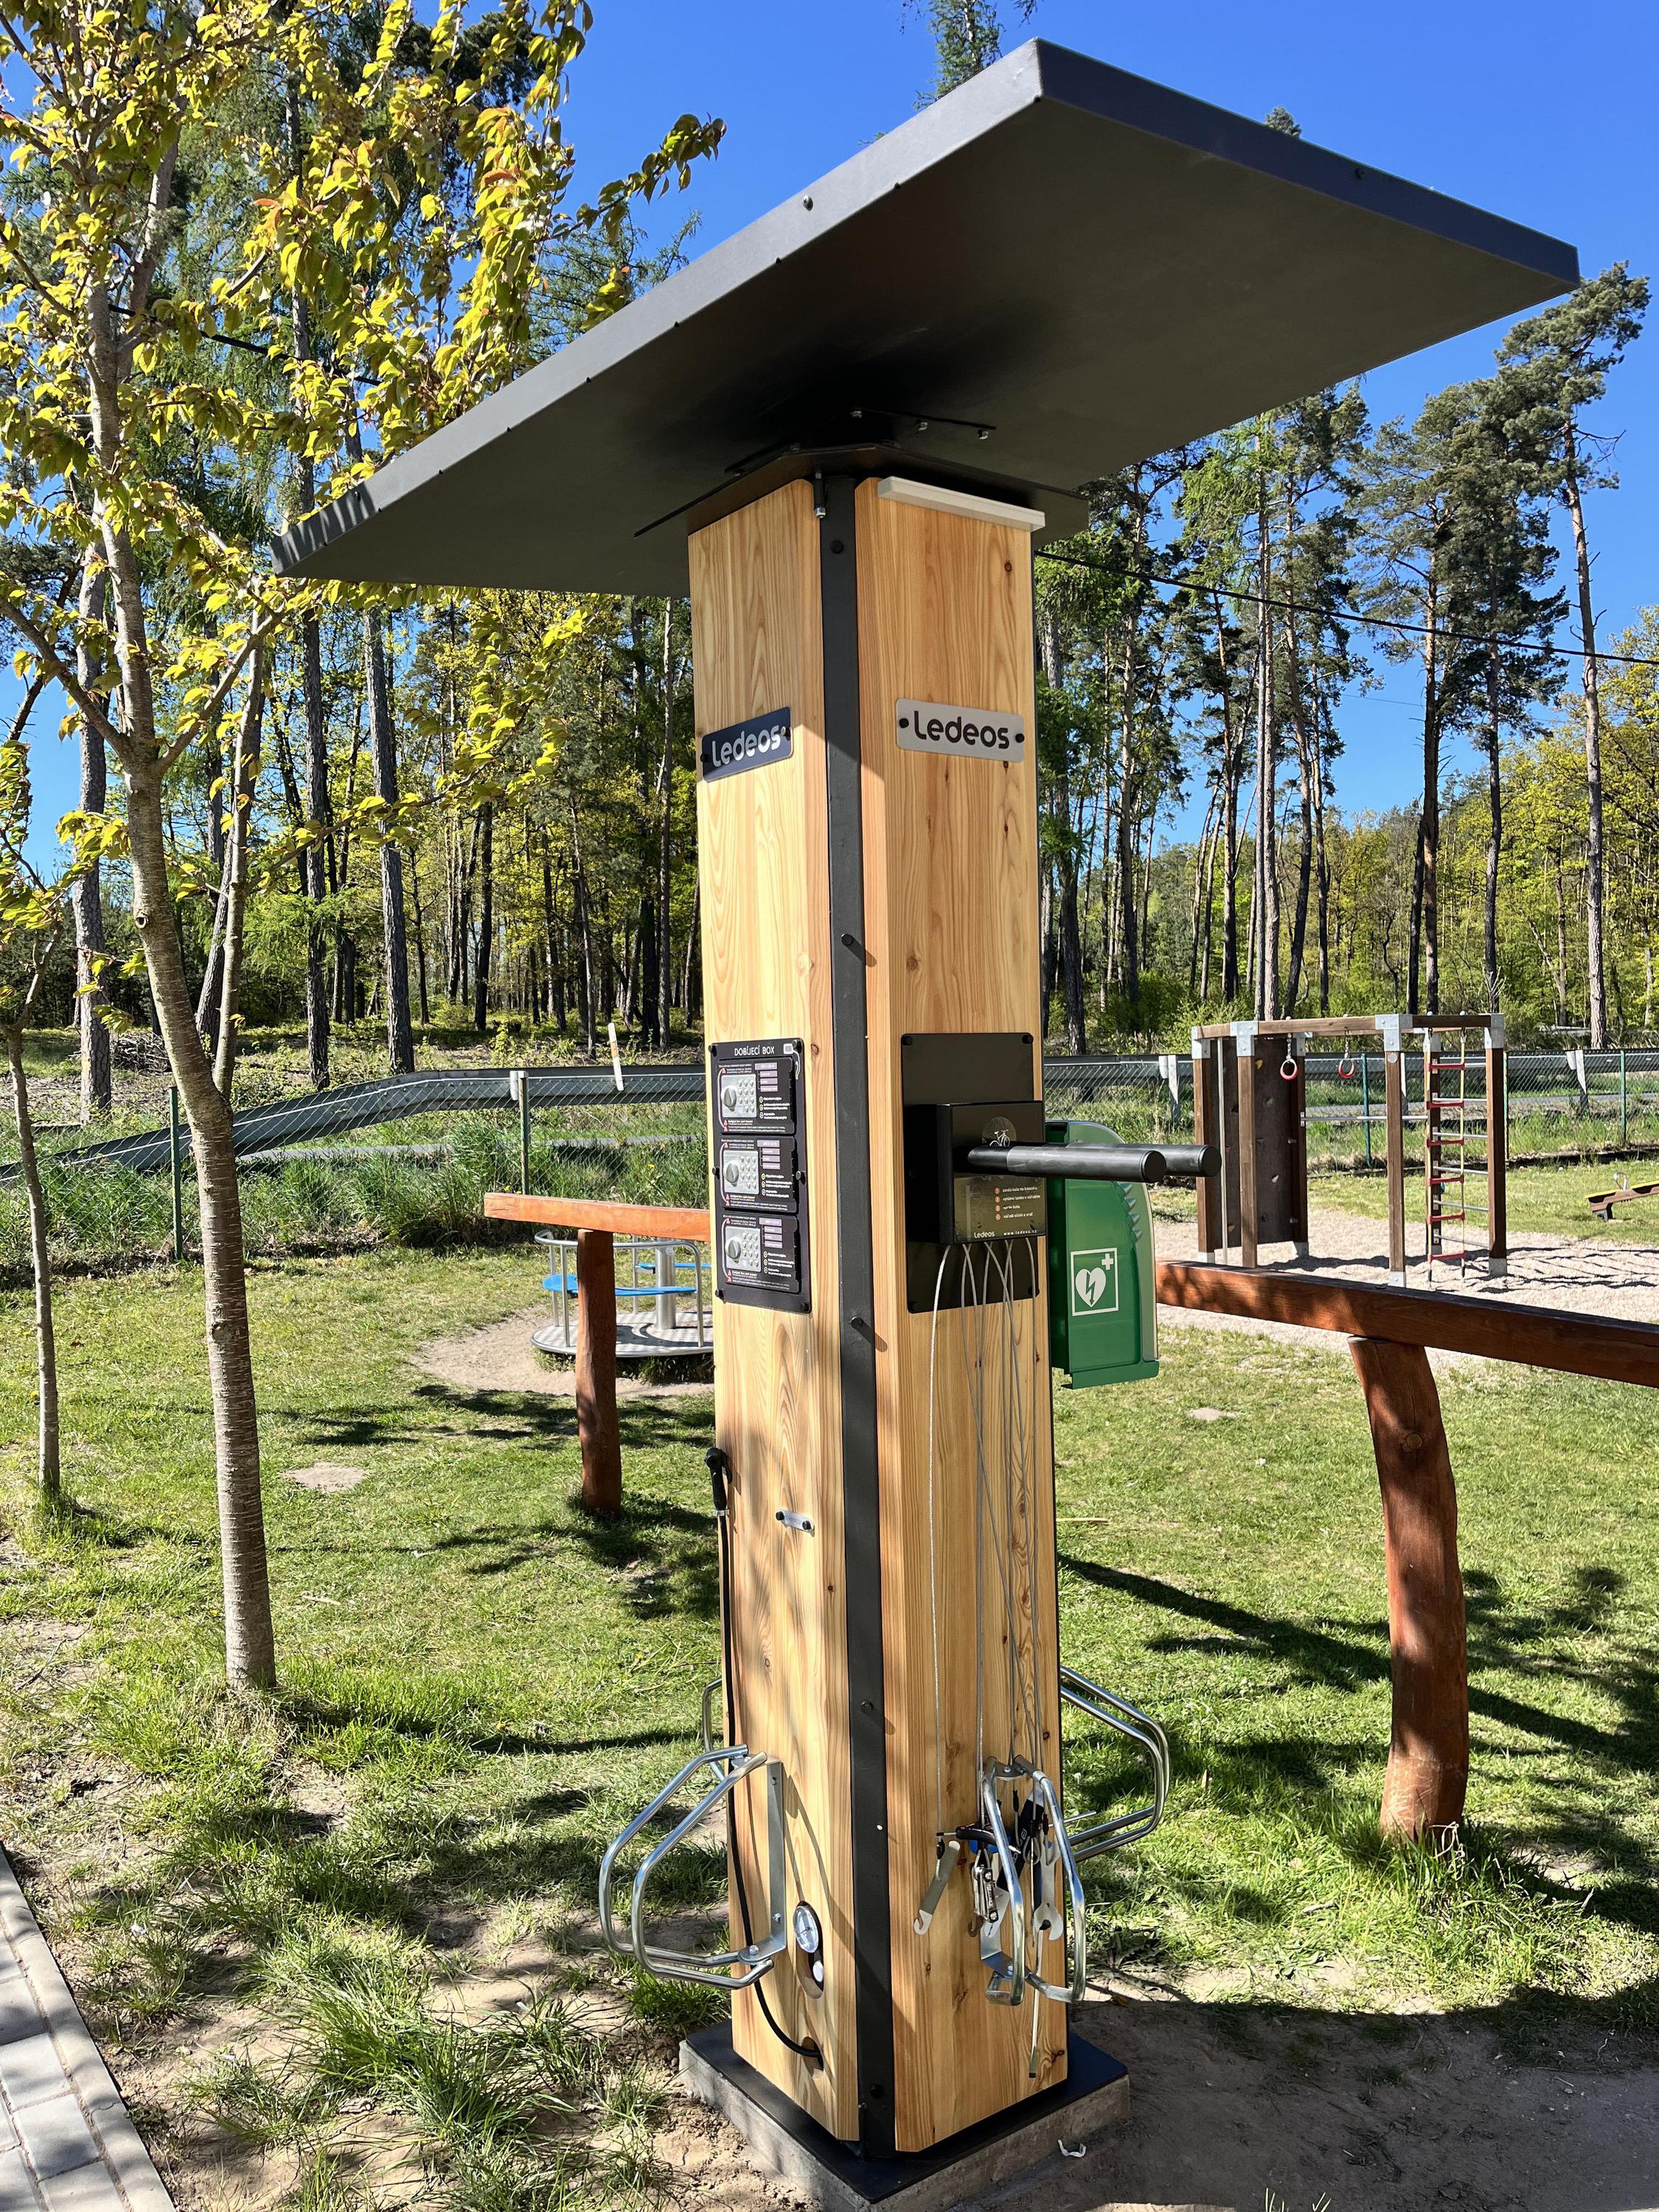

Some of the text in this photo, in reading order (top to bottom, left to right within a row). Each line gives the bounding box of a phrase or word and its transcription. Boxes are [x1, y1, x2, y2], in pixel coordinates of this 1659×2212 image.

[711, 725, 781, 768] Ledeos
[914, 710, 1009, 749] Ledeos
[734, 1045, 775, 1056] DOBÍJECÍ BOX
